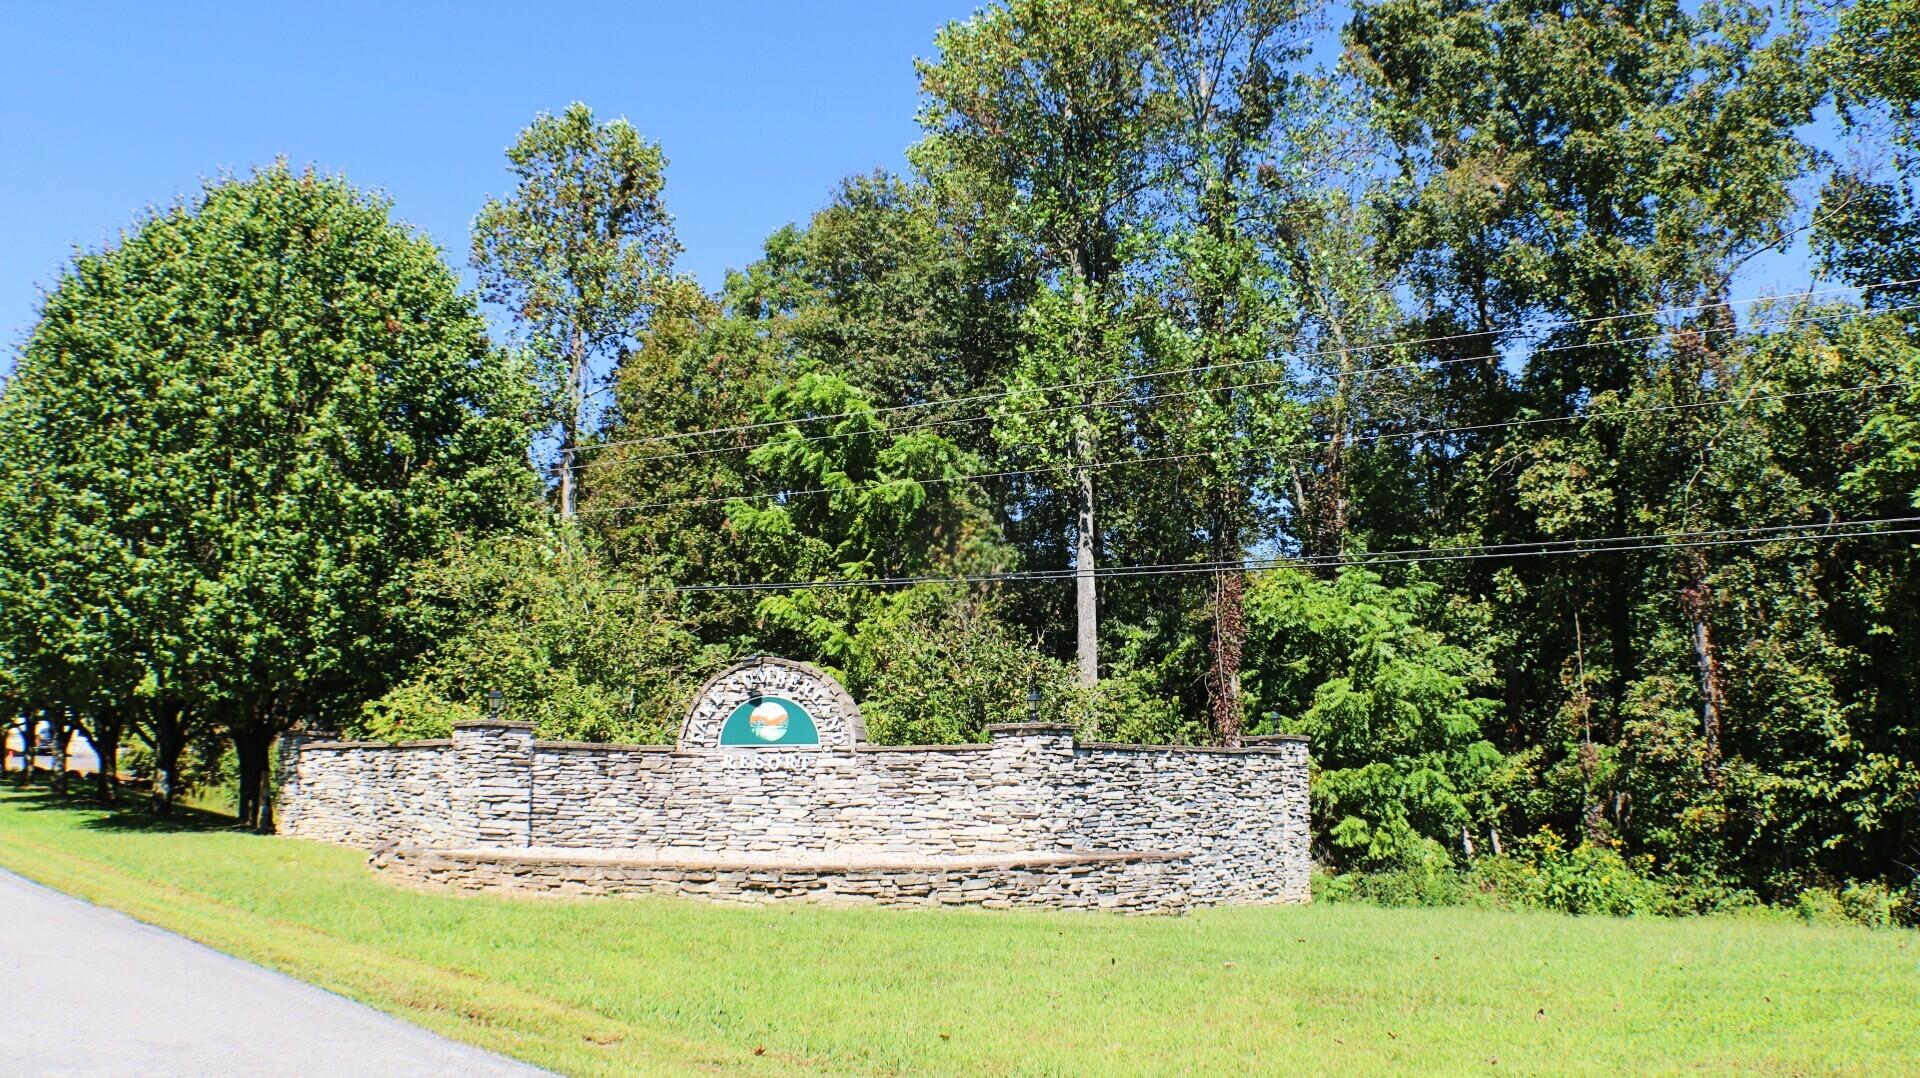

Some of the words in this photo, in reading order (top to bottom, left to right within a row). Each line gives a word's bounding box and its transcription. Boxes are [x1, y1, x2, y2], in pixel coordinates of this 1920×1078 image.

[692, 691, 725, 743] LAKE
[729, 667, 845, 745] CUMBERLAND
[722, 754, 811, 771] RESORT
